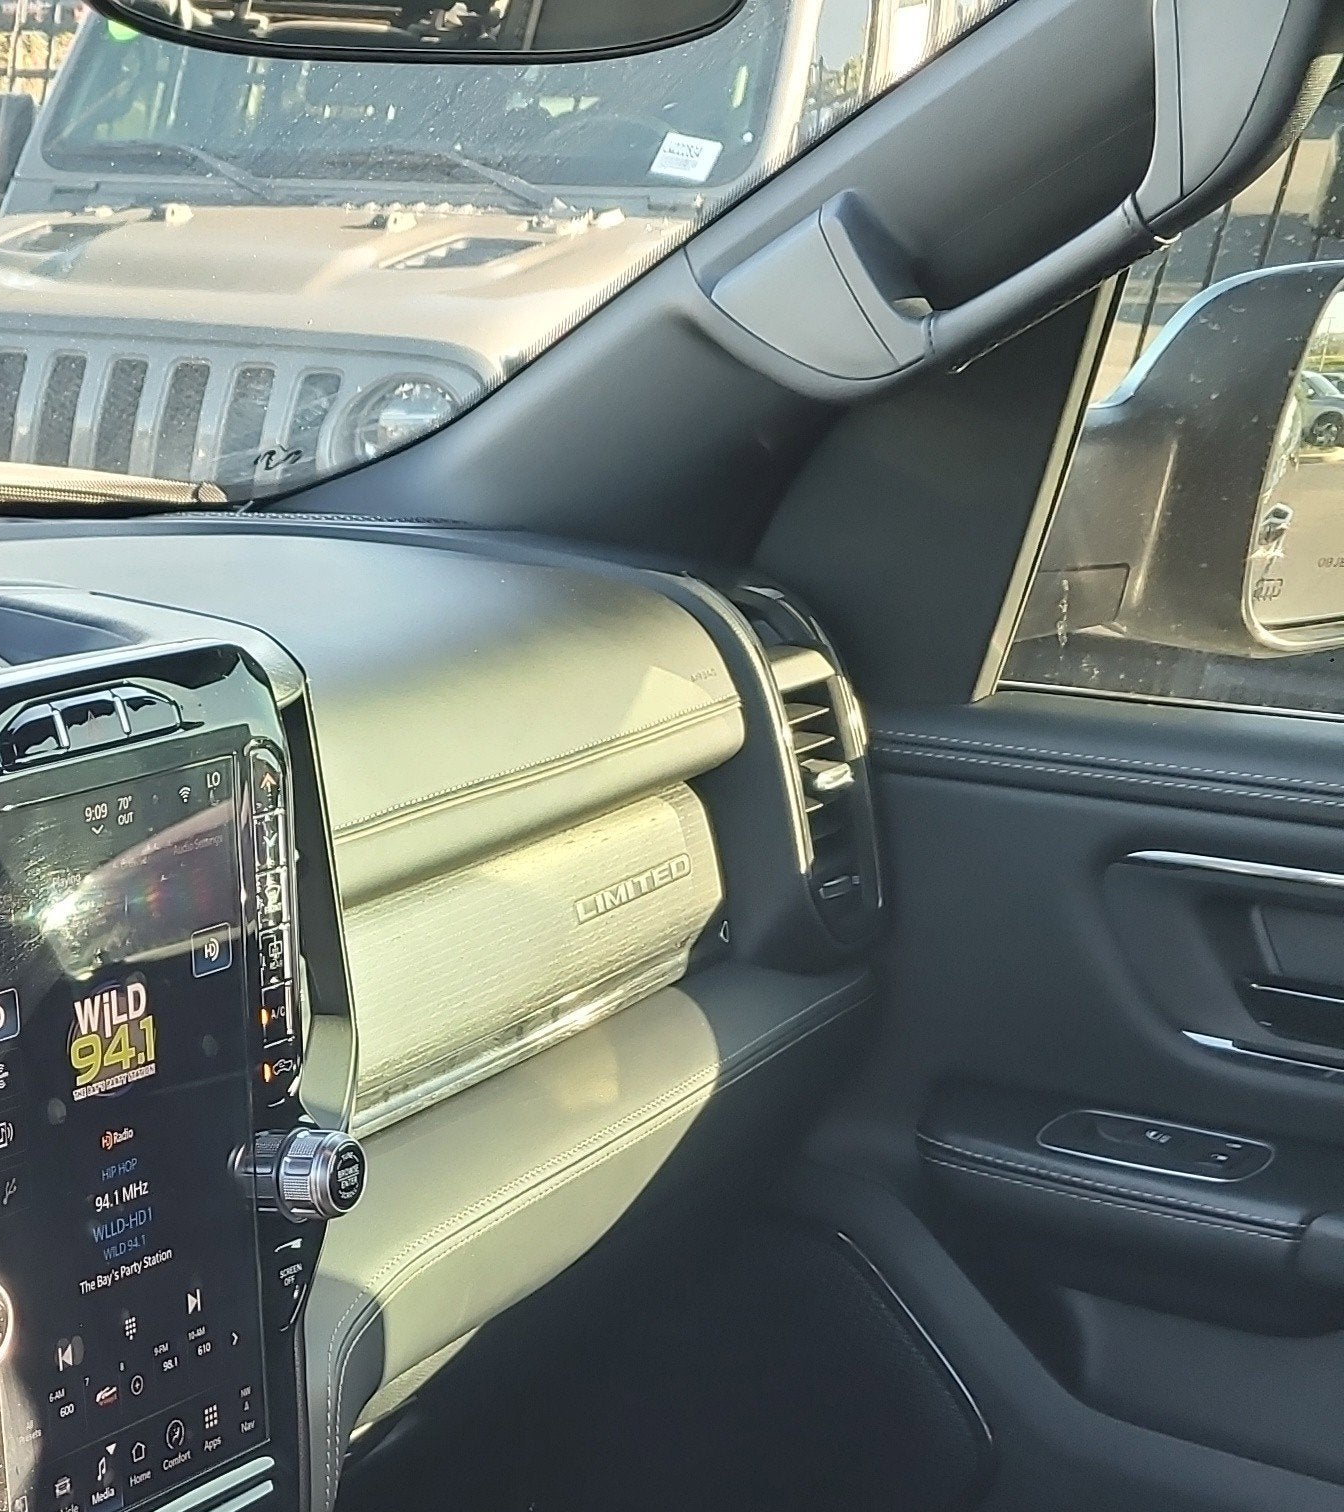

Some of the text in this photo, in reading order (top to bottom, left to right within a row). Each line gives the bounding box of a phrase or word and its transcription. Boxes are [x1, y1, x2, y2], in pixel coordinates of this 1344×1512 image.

[205, 771, 221, 788] LO
[84, 803, 108, 823] 9:09
[117, 812, 134, 825] OUT
[575, 855, 691, 924] LIMITED
[271, 1005, 286, 1020] A/C
[70, 1015, 155, 1087] 94.1
[113, 1127, 134, 1145] Radio
[101, 1157, 138, 1182] HIP HOP
[95, 1180, 149, 1213] 94.1 MHz
[92, 1206, 153, 1244] WLLD-HD1
[103, 1234, 146, 1262] WILD 94.1
[79, 1247, 173, 1295] The Bay's Party Station
[279, 1262, 303, 1280] SCREEN
[283, 1274, 296, 1287] OFF
[197, 1341, 211, 1356] 610
[162, 1356, 179, 1372] 98.1
[49, 1387, 65, 1403] 6-AM
[240, 1385, 252, 1399] NW
[59, 1402, 75, 1418] 600
[240, 1418, 255, 1433] Nav
[203, 1435, 222, 1453] Apps
[162, 1449, 191, 1471] Comfort
[129, 1469, 151, 1487] Home
[91, 1485, 115, 1506] Media
